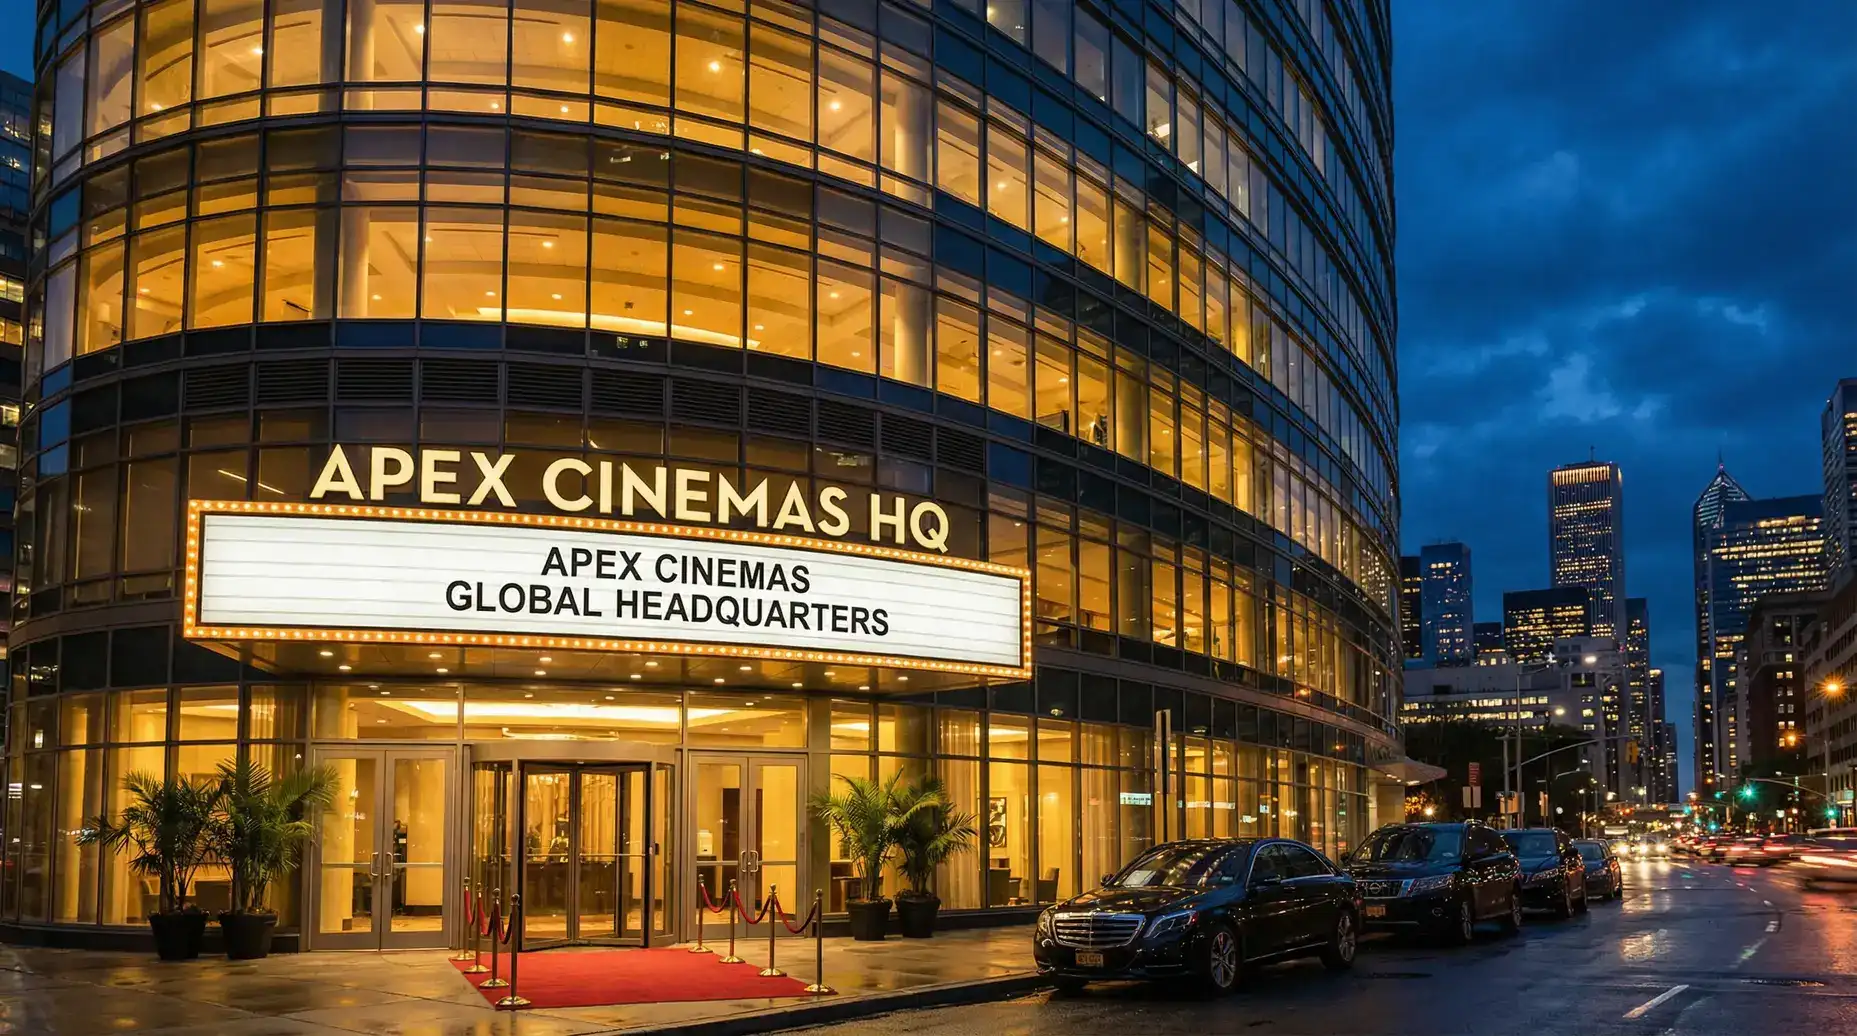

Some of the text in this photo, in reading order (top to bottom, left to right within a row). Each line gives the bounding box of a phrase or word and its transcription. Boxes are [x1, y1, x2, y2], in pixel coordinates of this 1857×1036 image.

[309, 443, 949, 554] APEX CINEMAS HQ
[540, 546, 811, 594] APEX CINEMAS
[445, 580, 889, 638] GLOBAL HEADQUARTERS
